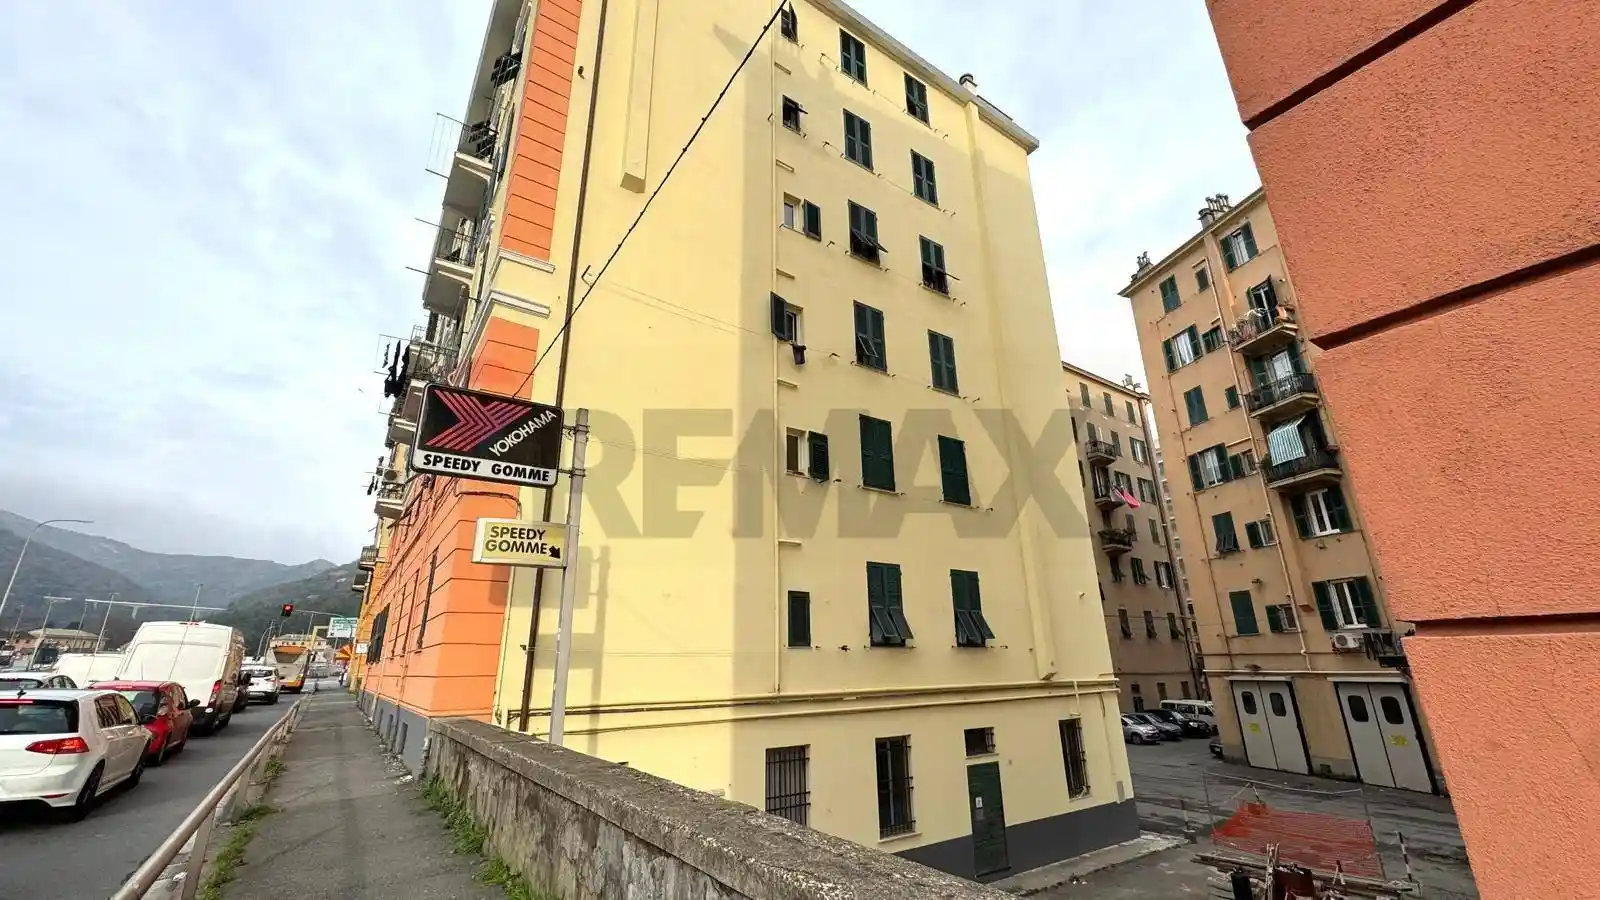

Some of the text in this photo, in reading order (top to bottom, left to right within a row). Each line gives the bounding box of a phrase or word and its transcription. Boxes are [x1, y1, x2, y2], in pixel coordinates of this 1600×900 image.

[488, 409, 558, 457] YOKOHAMA
[423, 453, 550, 482] SPEEDY GOMME
[490, 525, 546, 541] SPEEDY
[485, 539, 548, 555] GOMME
